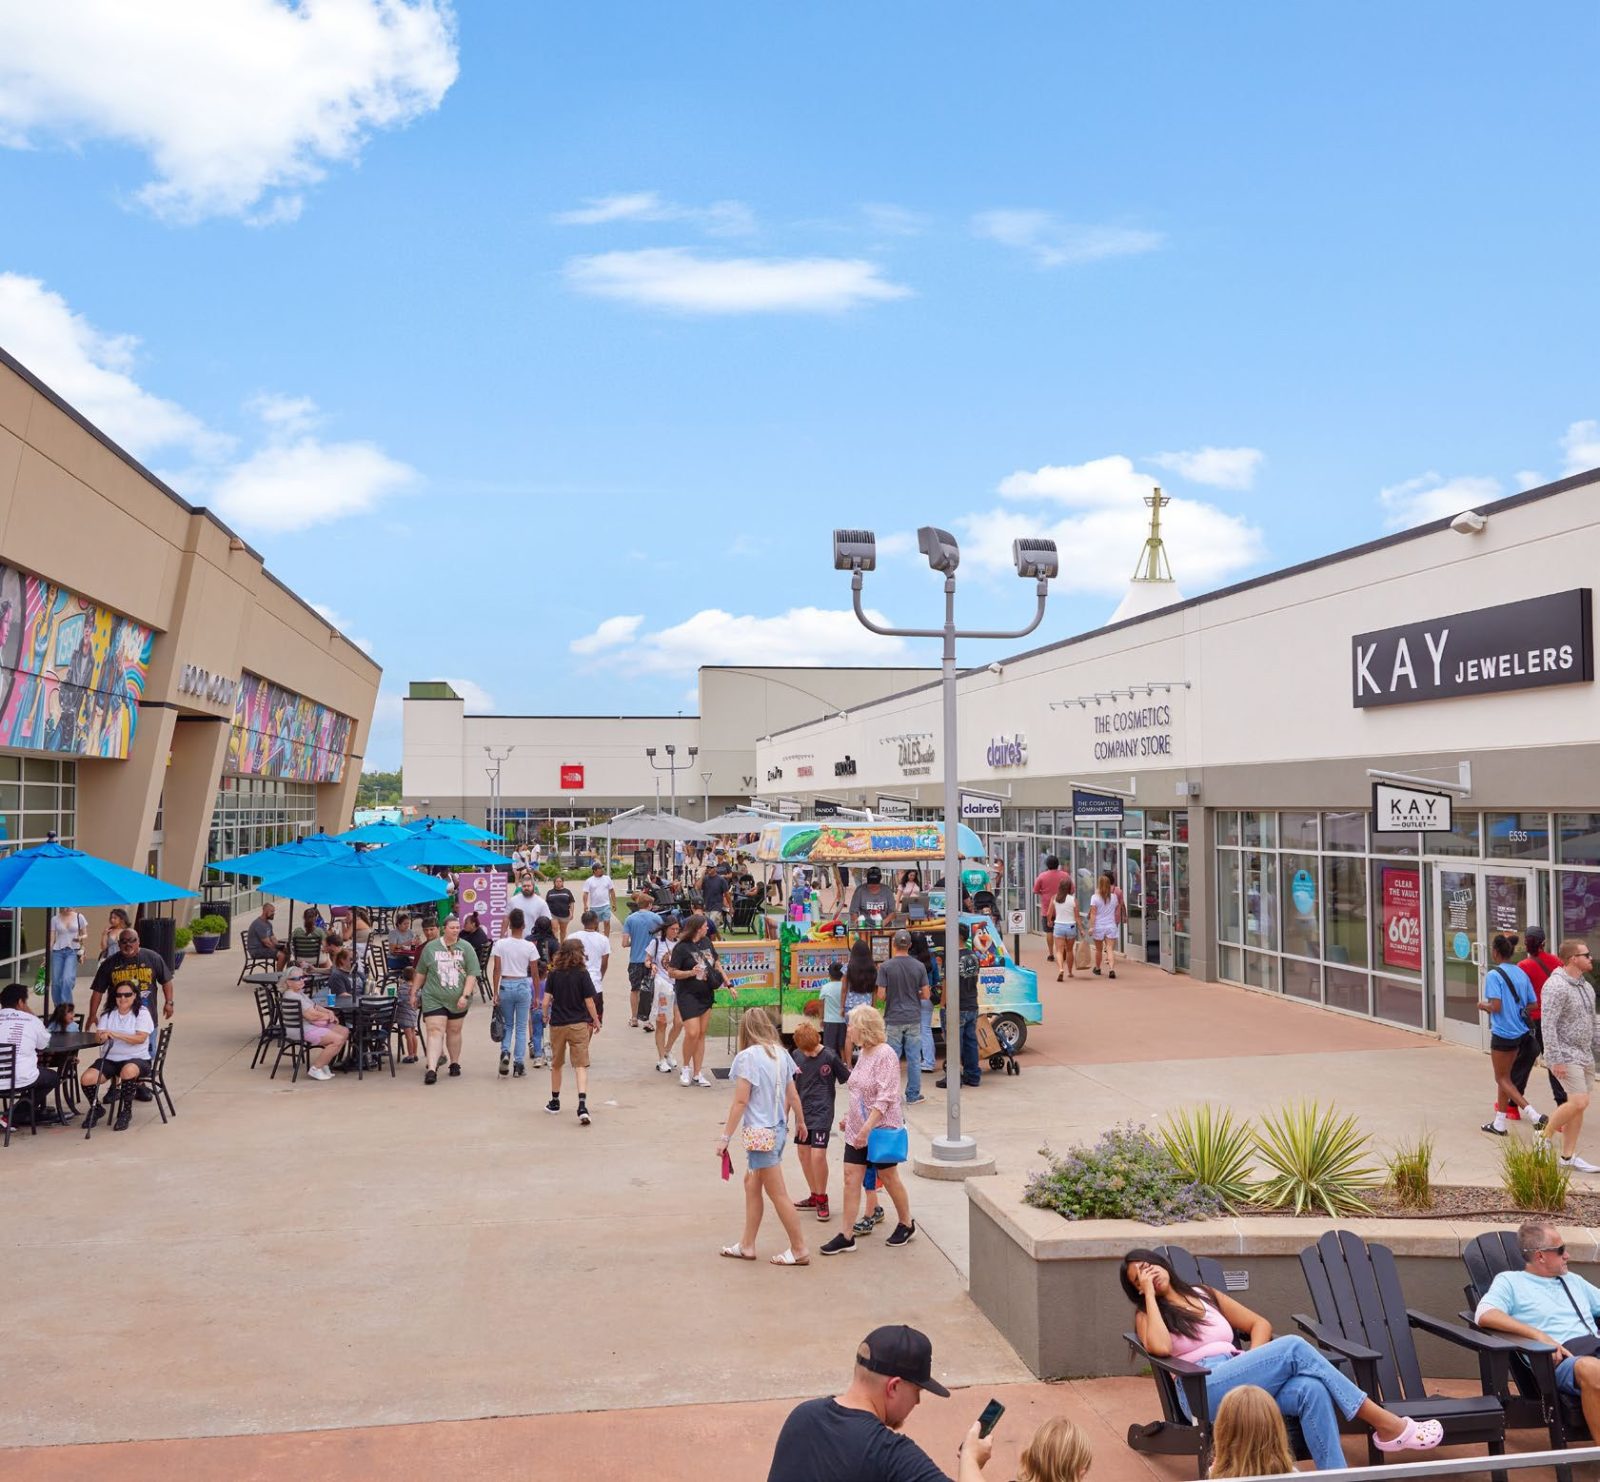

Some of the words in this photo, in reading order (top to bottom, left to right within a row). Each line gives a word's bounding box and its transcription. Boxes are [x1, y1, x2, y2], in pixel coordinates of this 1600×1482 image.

[1357, 629, 1449, 696] KAY
[1455, 644, 1573, 683] JEWELERS
[1094, 714, 1110, 733] THE
[1113, 705, 1170, 731] COSMETICS
[898, 740, 921, 766] ZALES
[987, 734, 1023, 767] claire's
[1094, 738, 1138, 760] COMPANY
[1141, 734, 1170, 756] STORE
[963, 803, 1000, 814] claire's
[1391, 799, 1436, 814] KAY
[914, 834, 941, 851] ICE
[1509, 831, 1527, 842] E535
[1394, 880, 1413, 888] CLEAR
[490, 874, 507, 916] COURT
[1389, 888, 1400, 896] THE
[1401, 889, 1419, 898] VAULT
[1455, 889, 1471, 902] OPEN
[1389, 916, 1419, 944] 60%
[1409, 938, 1419, 946] OFF
[111, 968, 153, 985] CHAMPIONS
